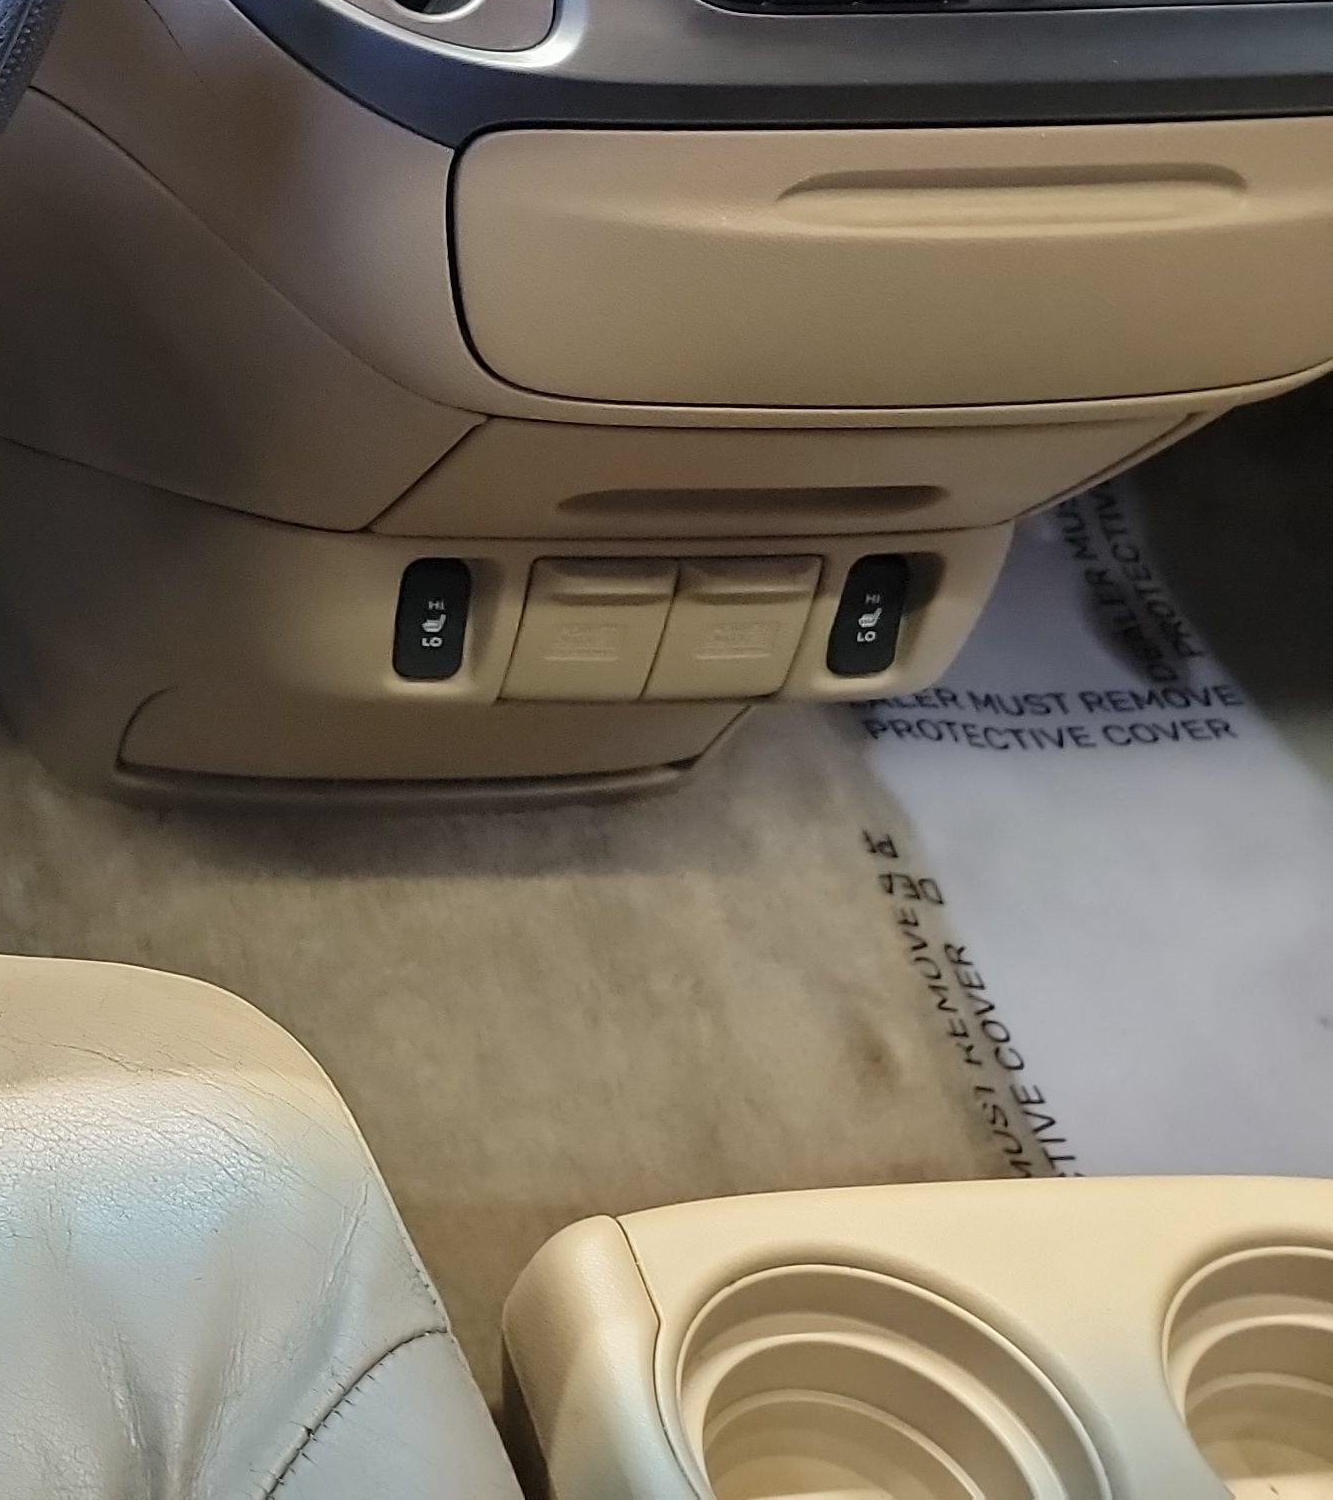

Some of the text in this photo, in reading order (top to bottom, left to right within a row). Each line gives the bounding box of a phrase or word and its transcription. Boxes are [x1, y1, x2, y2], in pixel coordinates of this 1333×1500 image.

[428, 600, 445, 611] HI
[865, 593, 881, 605] HI
[421, 636, 443, 647] LO
[856, 630, 877, 643] LO
[966, 684, 1244, 717] MUST REMOVE
[863, 717, 1240, 752] PROTECTIVE COVER
[944, 942, 1025, 1071] COVER
